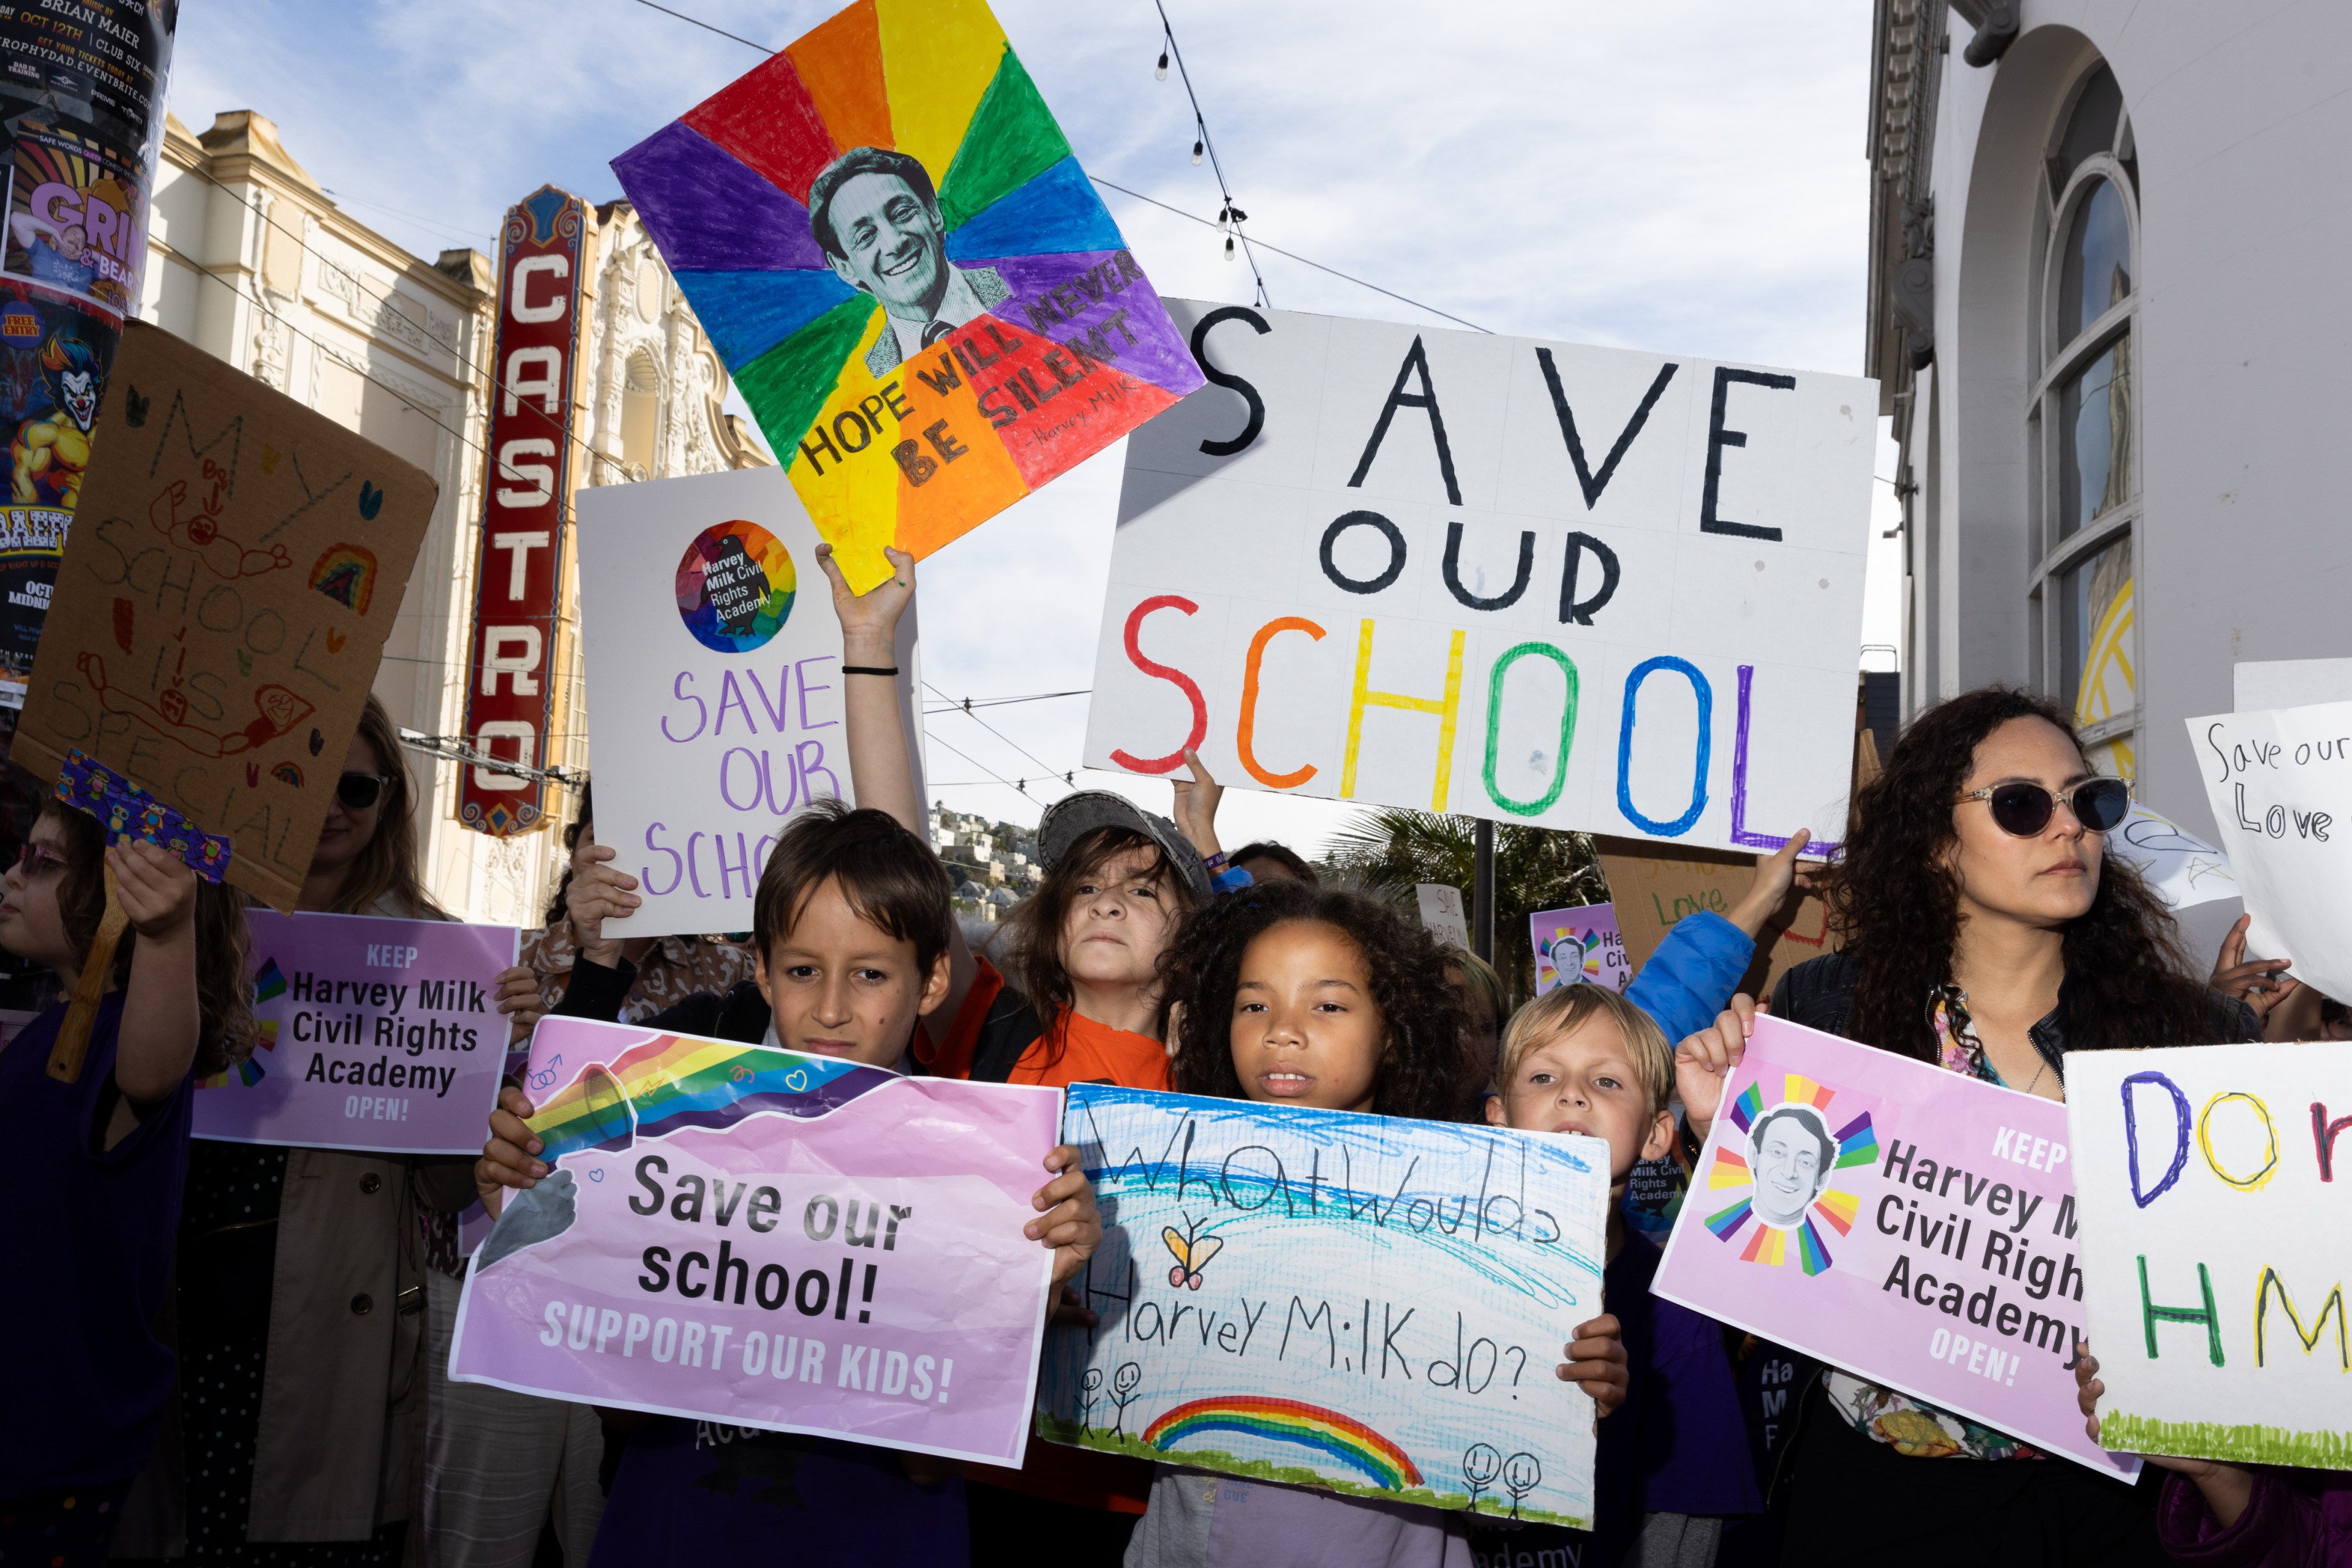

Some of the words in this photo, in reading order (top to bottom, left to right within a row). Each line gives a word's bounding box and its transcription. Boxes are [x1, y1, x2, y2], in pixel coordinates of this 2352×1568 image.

[40, 0, 96, 24] BRIAN
[98, 15, 139, 49] MAIER
[82, 0, 104, 12] MUSIC
[105, 7, 114, 17] BY
[13, 61, 28, 70] DAD
[20, 11, 49, 29] OCT
[51, 21, 83, 42] 12TH
[96, 39, 123, 60] CLUB
[126, 55, 141, 72] SIX
[37, 37, 53, 48] GET
[56, 41, 75, 56] YOUR
[78, 49, 105, 68] TICKETS
[107, 63, 125, 78] TODAY
[126, 75, 134, 84] AT
[8, 65, 40, 79] TRAINING
[91, 89, 116, 107] PRIME
[39, 135, 56, 146] SAFE
[58, 140, 82, 154] WORDS
[83, 149, 102, 162] QUEER
[102, 157, 123, 172] COMEDY
[80, 247, 94, 270] &
[99, 254, 134, 293] BEAR
[3, 325, 40, 336] ENTRY
[7, 315, 34, 326] FREE
[797, 380, 916, 477] HOPE
[916, 323, 1023, 397] WILL
[1022, 249, 1144, 336] NEVER
[890, 418, 970, 488] BE
[977, 306, 1139, 431] SILENT
[1189, 305, 1796, 541] SAVE
[149, 388, 354, 544] MY
[473, 253, 569, 791] CASTRO
[9, 561, 29, 570] RIGHT
[702, 552, 744, 576] Harvey
[706, 571, 735, 592] Milk
[737, 560, 763, 579] Civil
[1318, 509, 1621, 626] OUR
[26, 580, 54, 598] OCT
[85, 517, 341, 693] SCHOOL
[710, 586, 748, 606] Rights
[716, 594, 771, 623] Academy
[151, 645, 227, 721] IS
[661, 655, 840, 744] SAVE
[1109, 594, 1841, 858] SCHOOL
[2208, 723, 2281, 783] Save
[2295, 737, 2351, 766] our
[45, 680, 301, 876] SPECIAL
[720, 740, 841, 816] OUR
[2235, 782, 2332, 842] Love
[366, 944, 418, 969] KEEP
[293, 971, 408, 1015] Harvey
[418, 979, 488, 1014] Milk
[293, 1011, 362, 1046] Civil
[374, 1016, 478, 1057] Rights
[305, 1052, 456, 1098] Academy
[344, 1095, 409, 1121] OPEN!
[1630, 1167, 1658, 1177] Milk
[1660, 1163, 1684, 1176] Civil
[1992, 1126, 2068, 1174] KEEP
[628, 1154, 782, 1234] Save
[803, 1194, 913, 1252] our
[1629, 1189, 1687, 1201] Academy
[1630, 1178, 1667, 1191] Rights
[1882, 1138, 2044, 1234] Harvey
[1875, 1193, 1969, 1262] Civil
[1981, 1229, 2084, 1302] Righ
[637, 1239, 880, 1324] school!
[1085, 1256, 1267, 1359] Harvey
[1882, 1254, 2089, 1371] Academy
[2136, 1254, 2351, 1373] HM
[539, 1300, 733, 1371] SUPPORT
[741, 1330, 825, 1385] OUR
[837, 1345, 954, 1404] KIDS!
[1761, 1359, 1794, 1385] Ha
[1929, 1327, 2021, 1387] OPEN!
[695, 1419, 779, 1451] Aca
